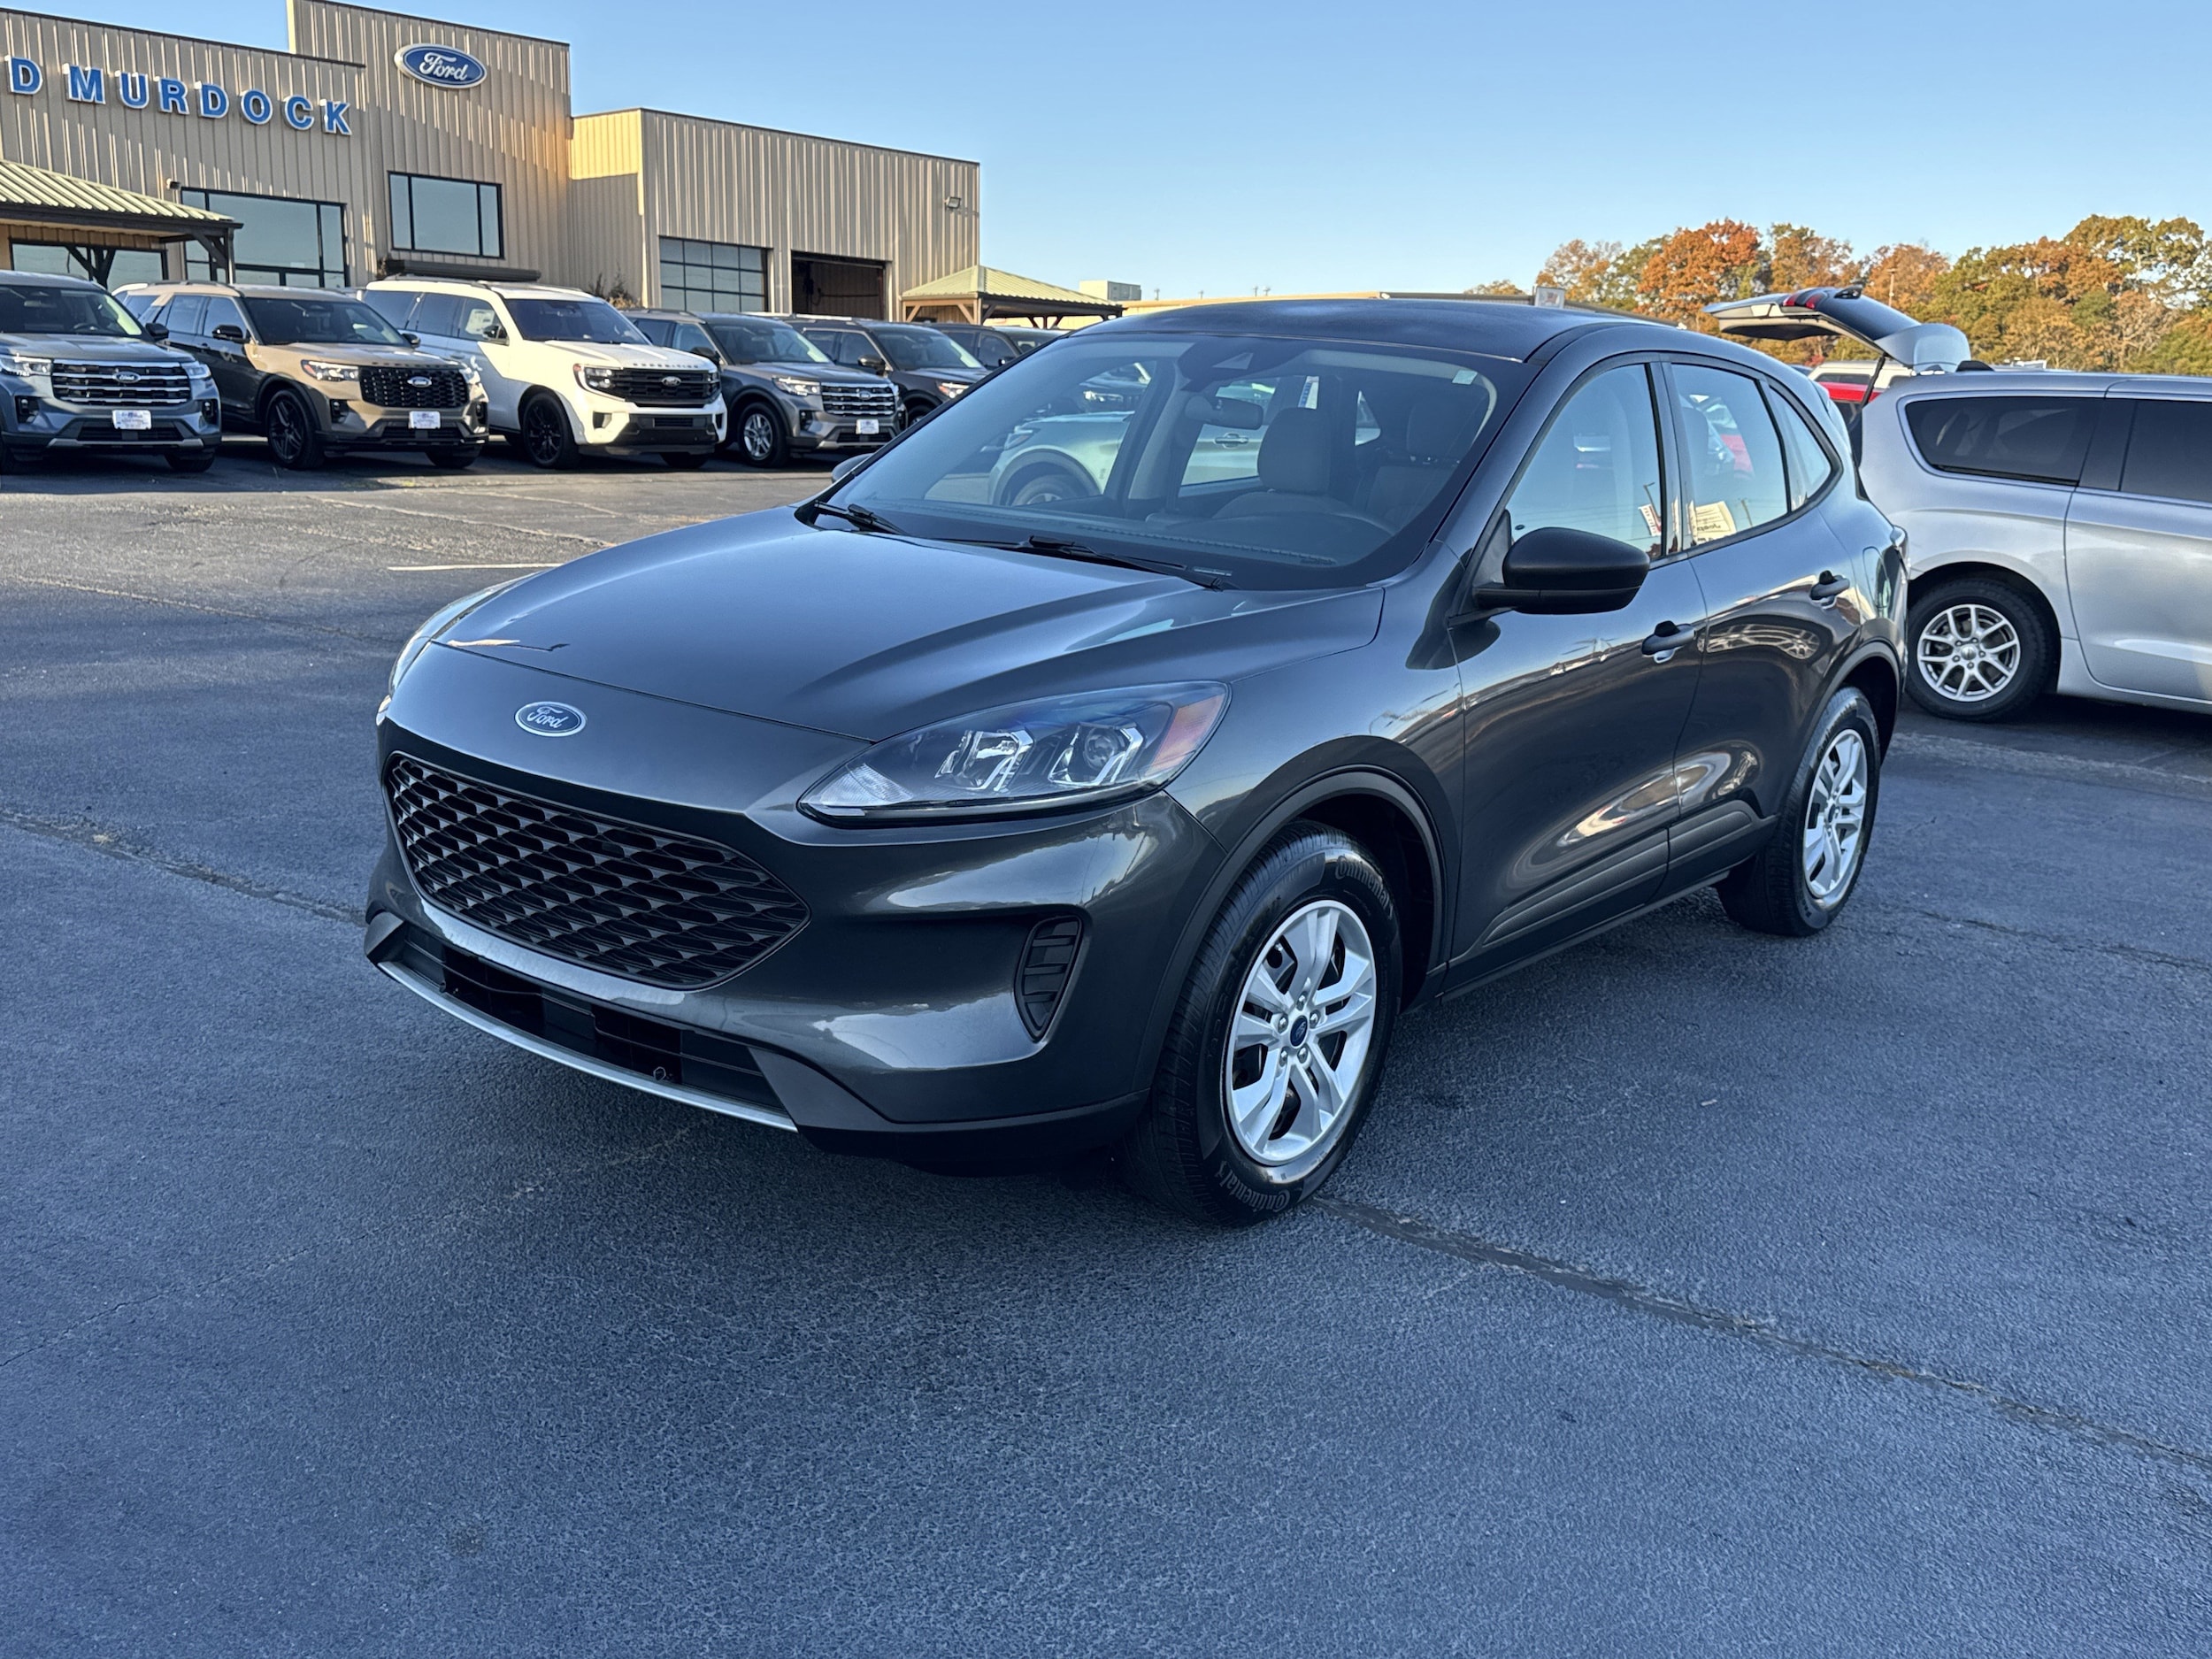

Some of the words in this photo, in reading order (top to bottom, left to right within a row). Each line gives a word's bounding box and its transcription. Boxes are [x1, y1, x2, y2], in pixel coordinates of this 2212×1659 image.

[419, 51, 469, 81] Ford
[9, 56, 42, 95] D
[66, 65, 352, 135] MURDOCK
[526, 706, 569, 728] Ford
[1334, 856, 1390, 910] Continental
[1218, 1169, 1291, 1213] Continental
